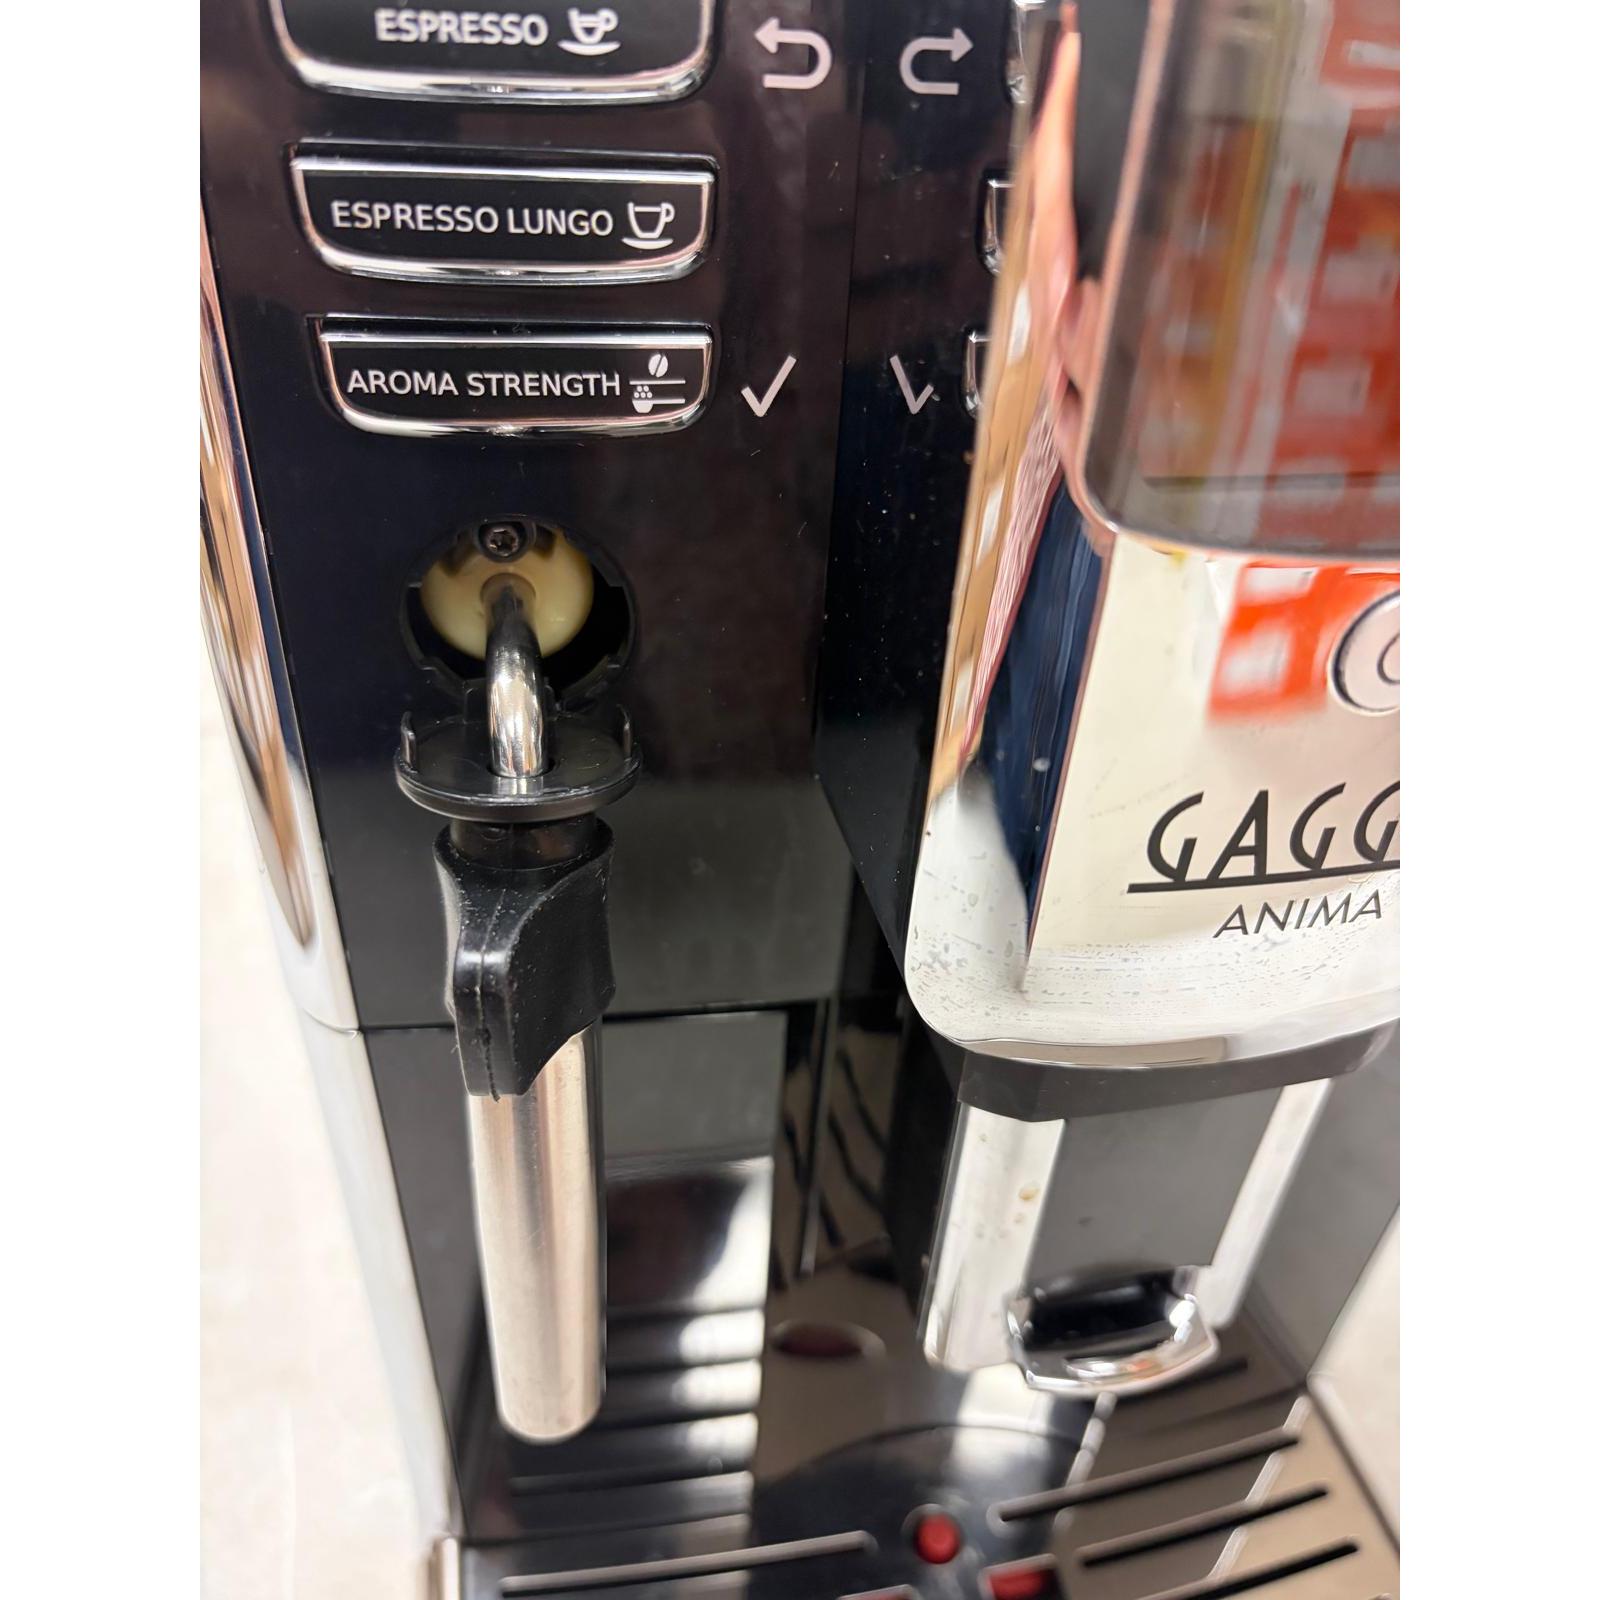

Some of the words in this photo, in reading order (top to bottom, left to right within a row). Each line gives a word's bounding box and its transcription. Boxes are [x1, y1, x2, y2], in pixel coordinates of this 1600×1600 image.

[374, 8, 549, 48] ESPRESSO
[331, 200, 499, 234] ESPRESSO
[506, 207, 613, 237] LUNGO
[347, 369, 458, 397] AROMA
[467, 371, 622, 399] STRENGTH
[1212, 888, 1382, 939] ANIMA
